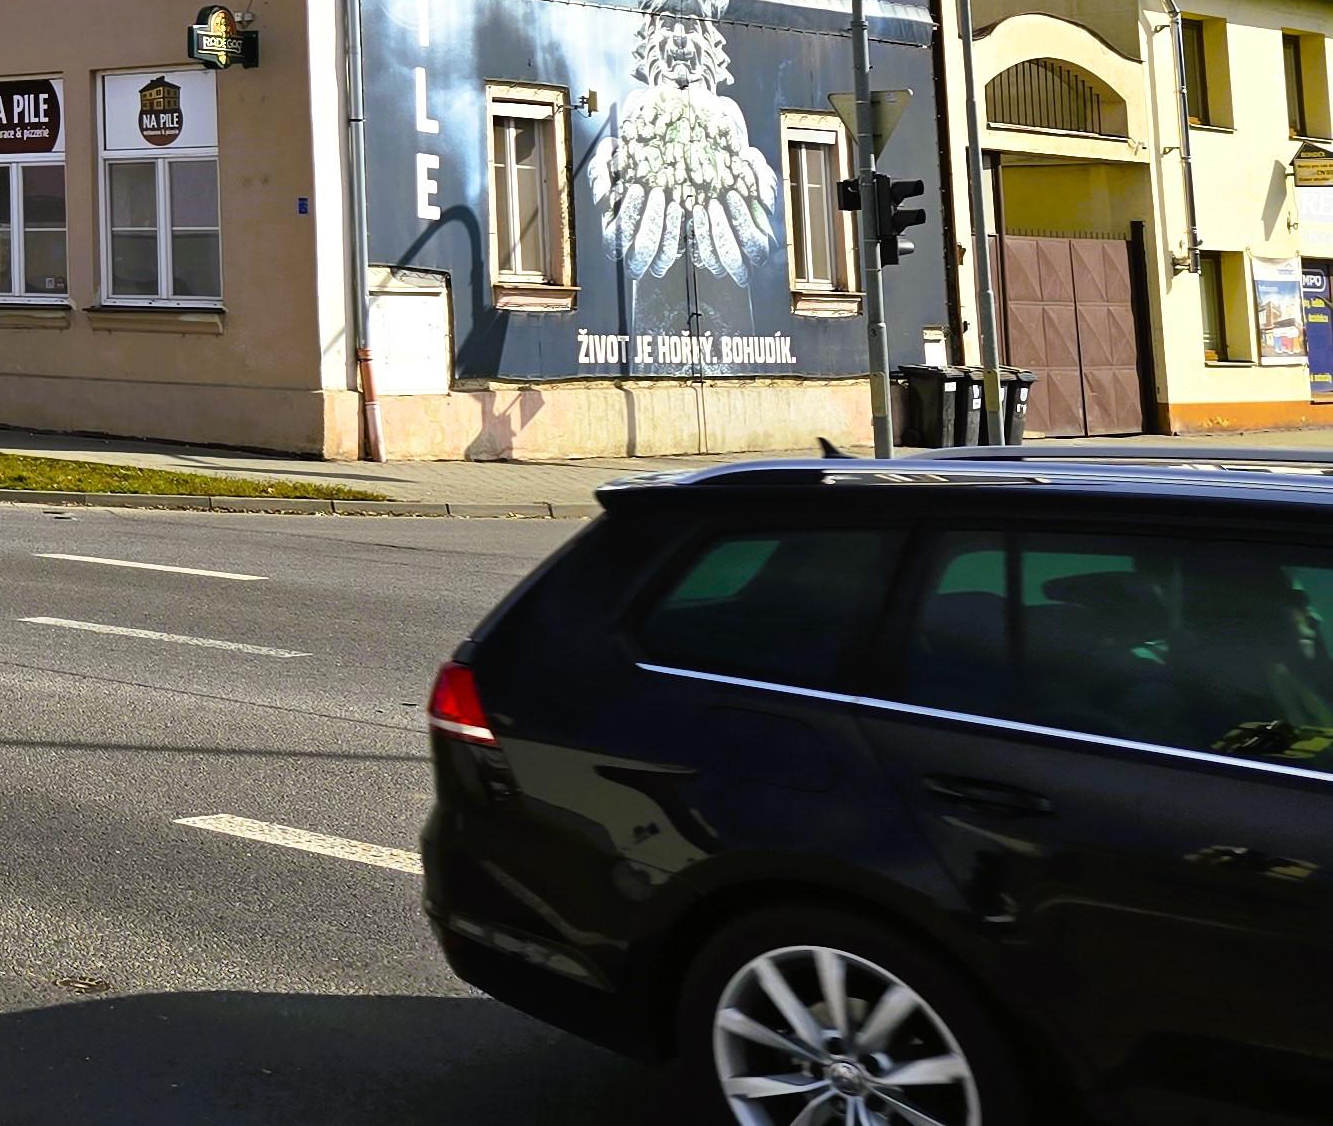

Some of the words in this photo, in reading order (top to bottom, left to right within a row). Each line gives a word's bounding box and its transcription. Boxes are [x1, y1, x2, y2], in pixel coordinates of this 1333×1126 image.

[13, 93, 49, 124] PILE
[142, 114, 158, 129] NA
[159, 112, 180, 128] PILE
[15, 127, 23, 138] &
[577, 328, 630, 364] ŽIVOT
[634, 335, 654, 364] JE
[721, 330, 798, 364] BOHUDÍK.
